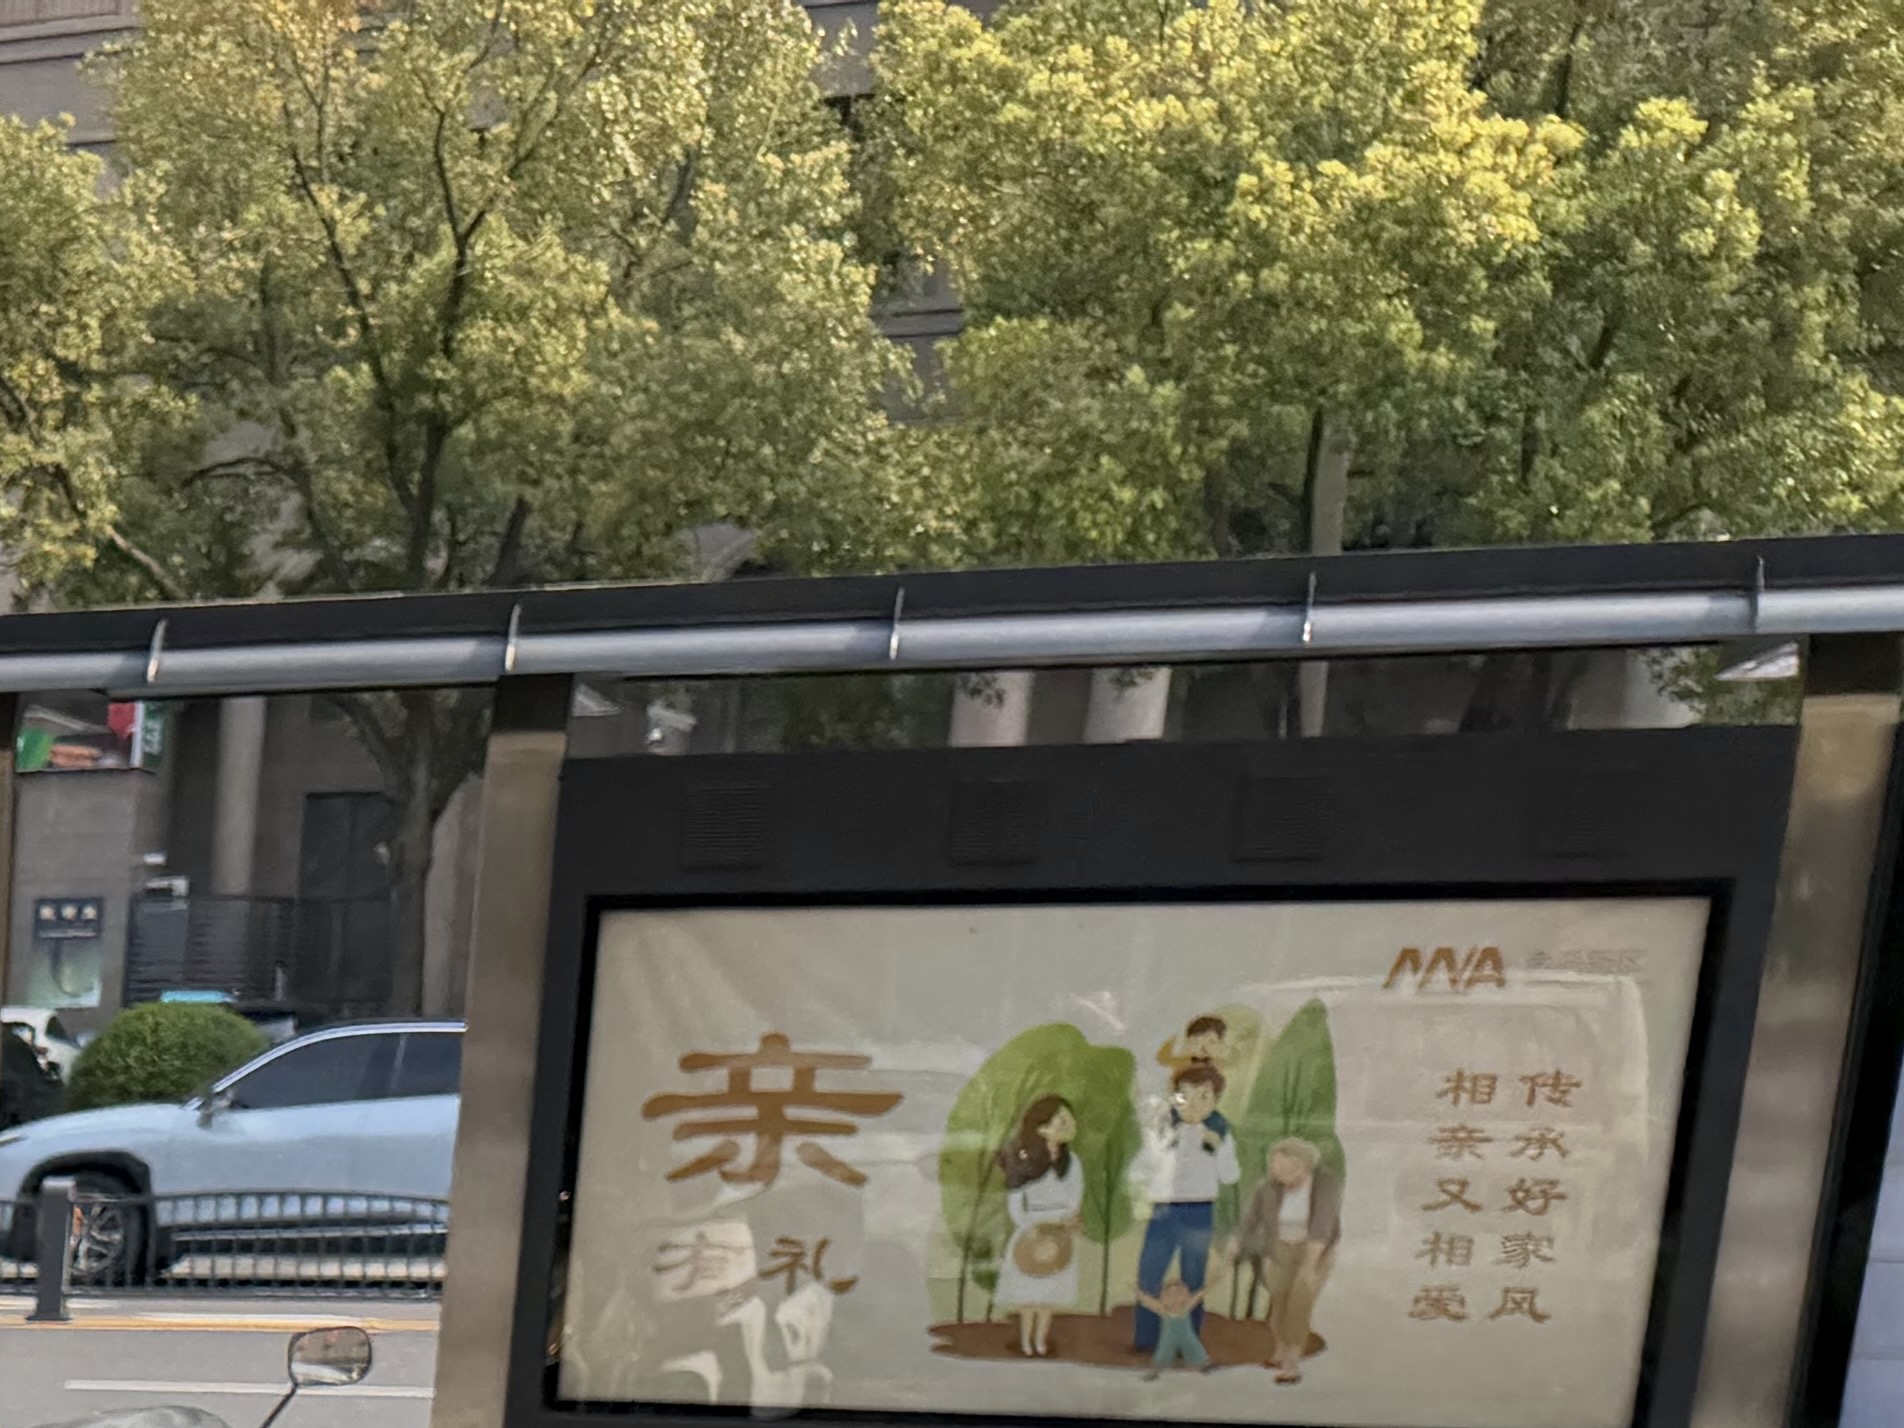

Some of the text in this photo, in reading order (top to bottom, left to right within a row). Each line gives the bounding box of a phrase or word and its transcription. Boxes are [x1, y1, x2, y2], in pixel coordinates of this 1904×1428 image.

[641, 1031, 905, 1190] 亲
[1407, 1067, 1500, 1322] 相亲又相爱
[1487, 1069, 1584, 1323] 传承好家风
